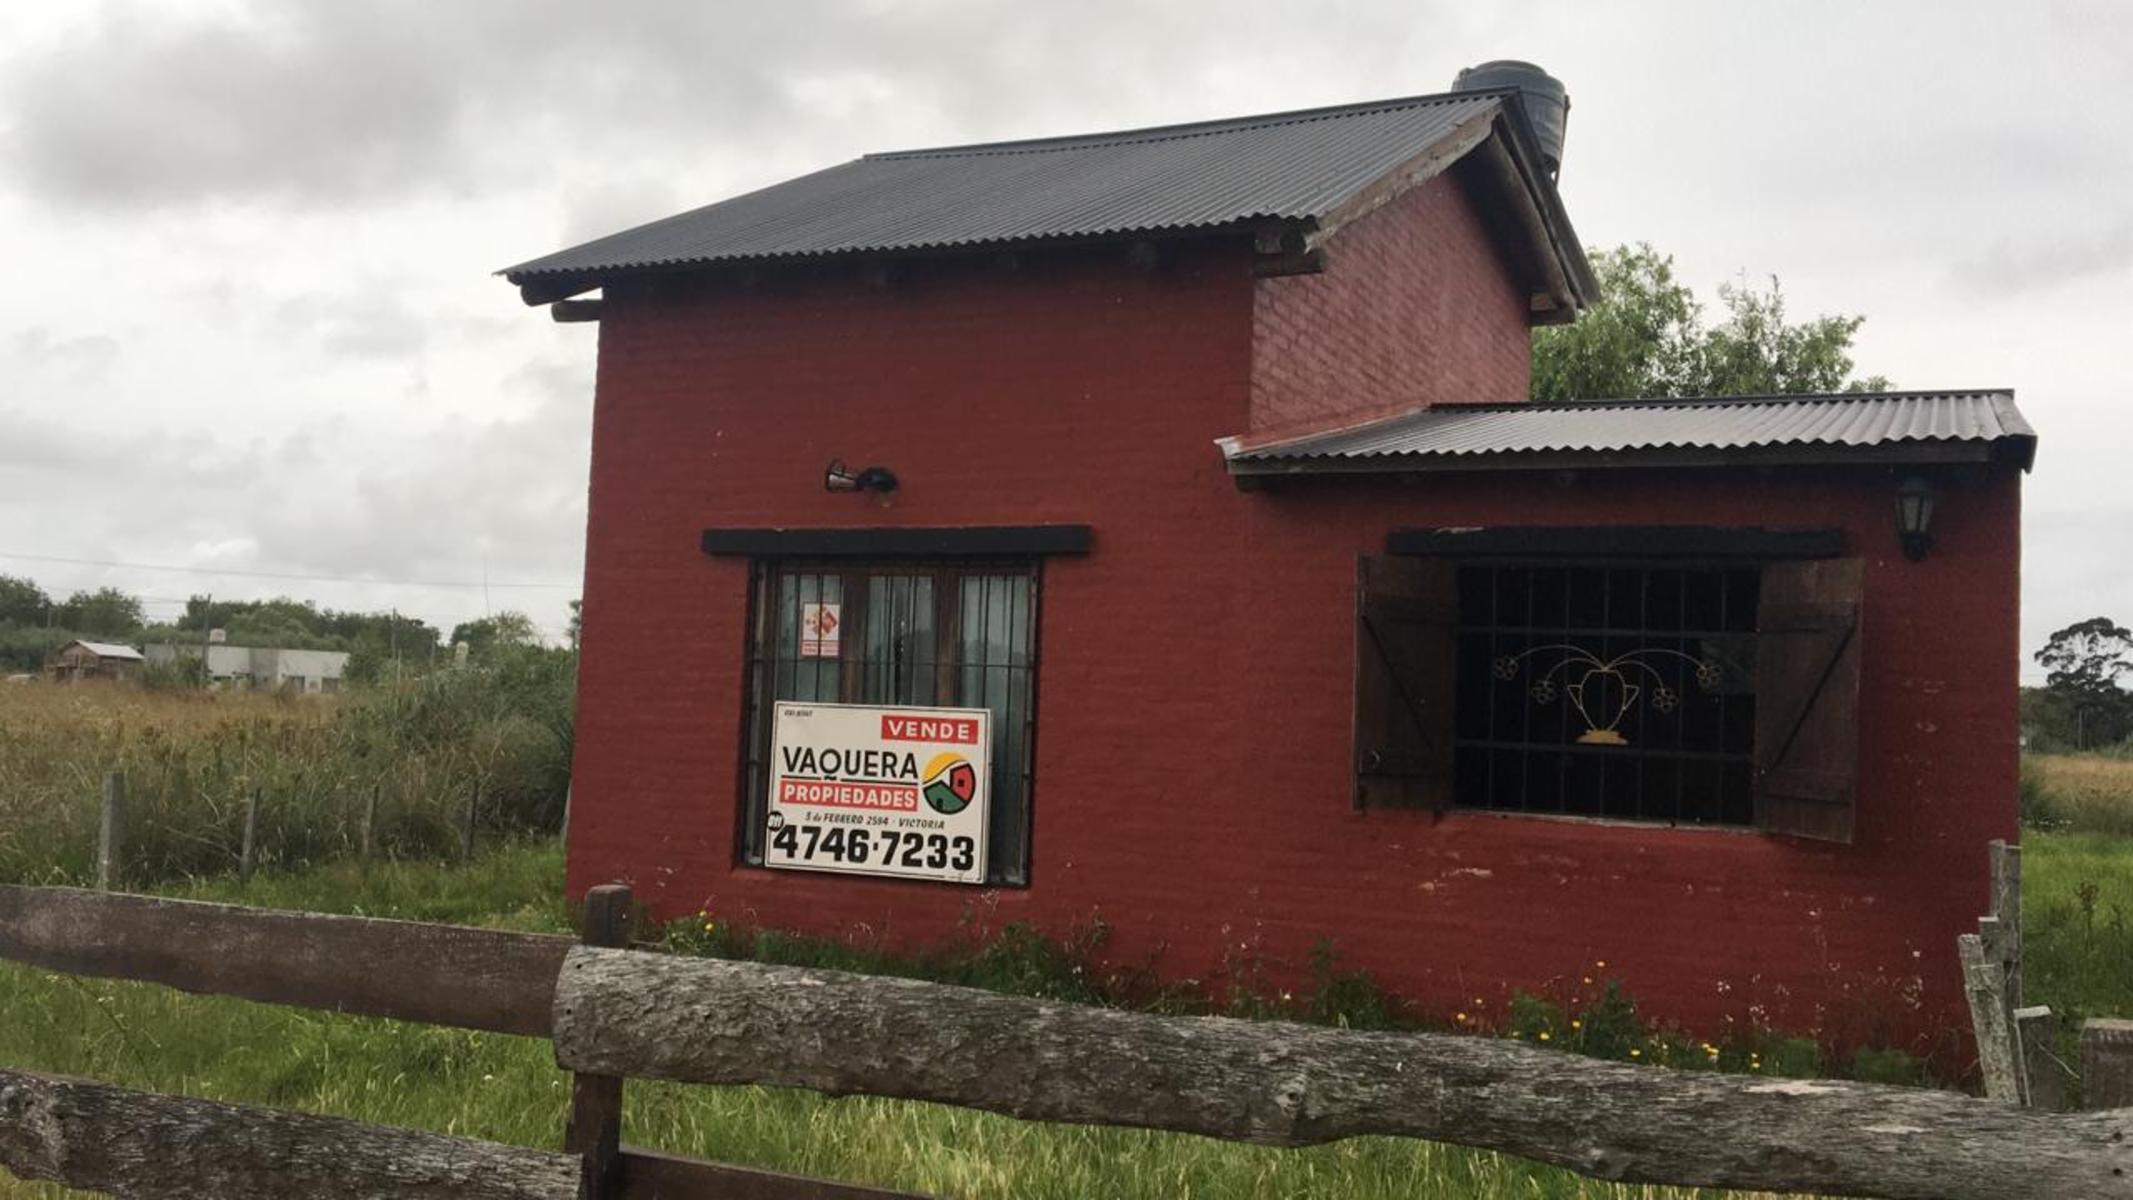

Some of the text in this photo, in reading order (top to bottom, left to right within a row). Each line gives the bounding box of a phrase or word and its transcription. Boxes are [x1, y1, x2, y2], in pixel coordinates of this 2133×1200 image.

[887, 719, 971, 740] VENDE
[782, 746, 919, 780] VAQUERA
[784, 784, 916, 808] PROPIEDADES
[823, 812, 865, 825] FEBRERO
[898, 817, 946, 830] VICTORIA
